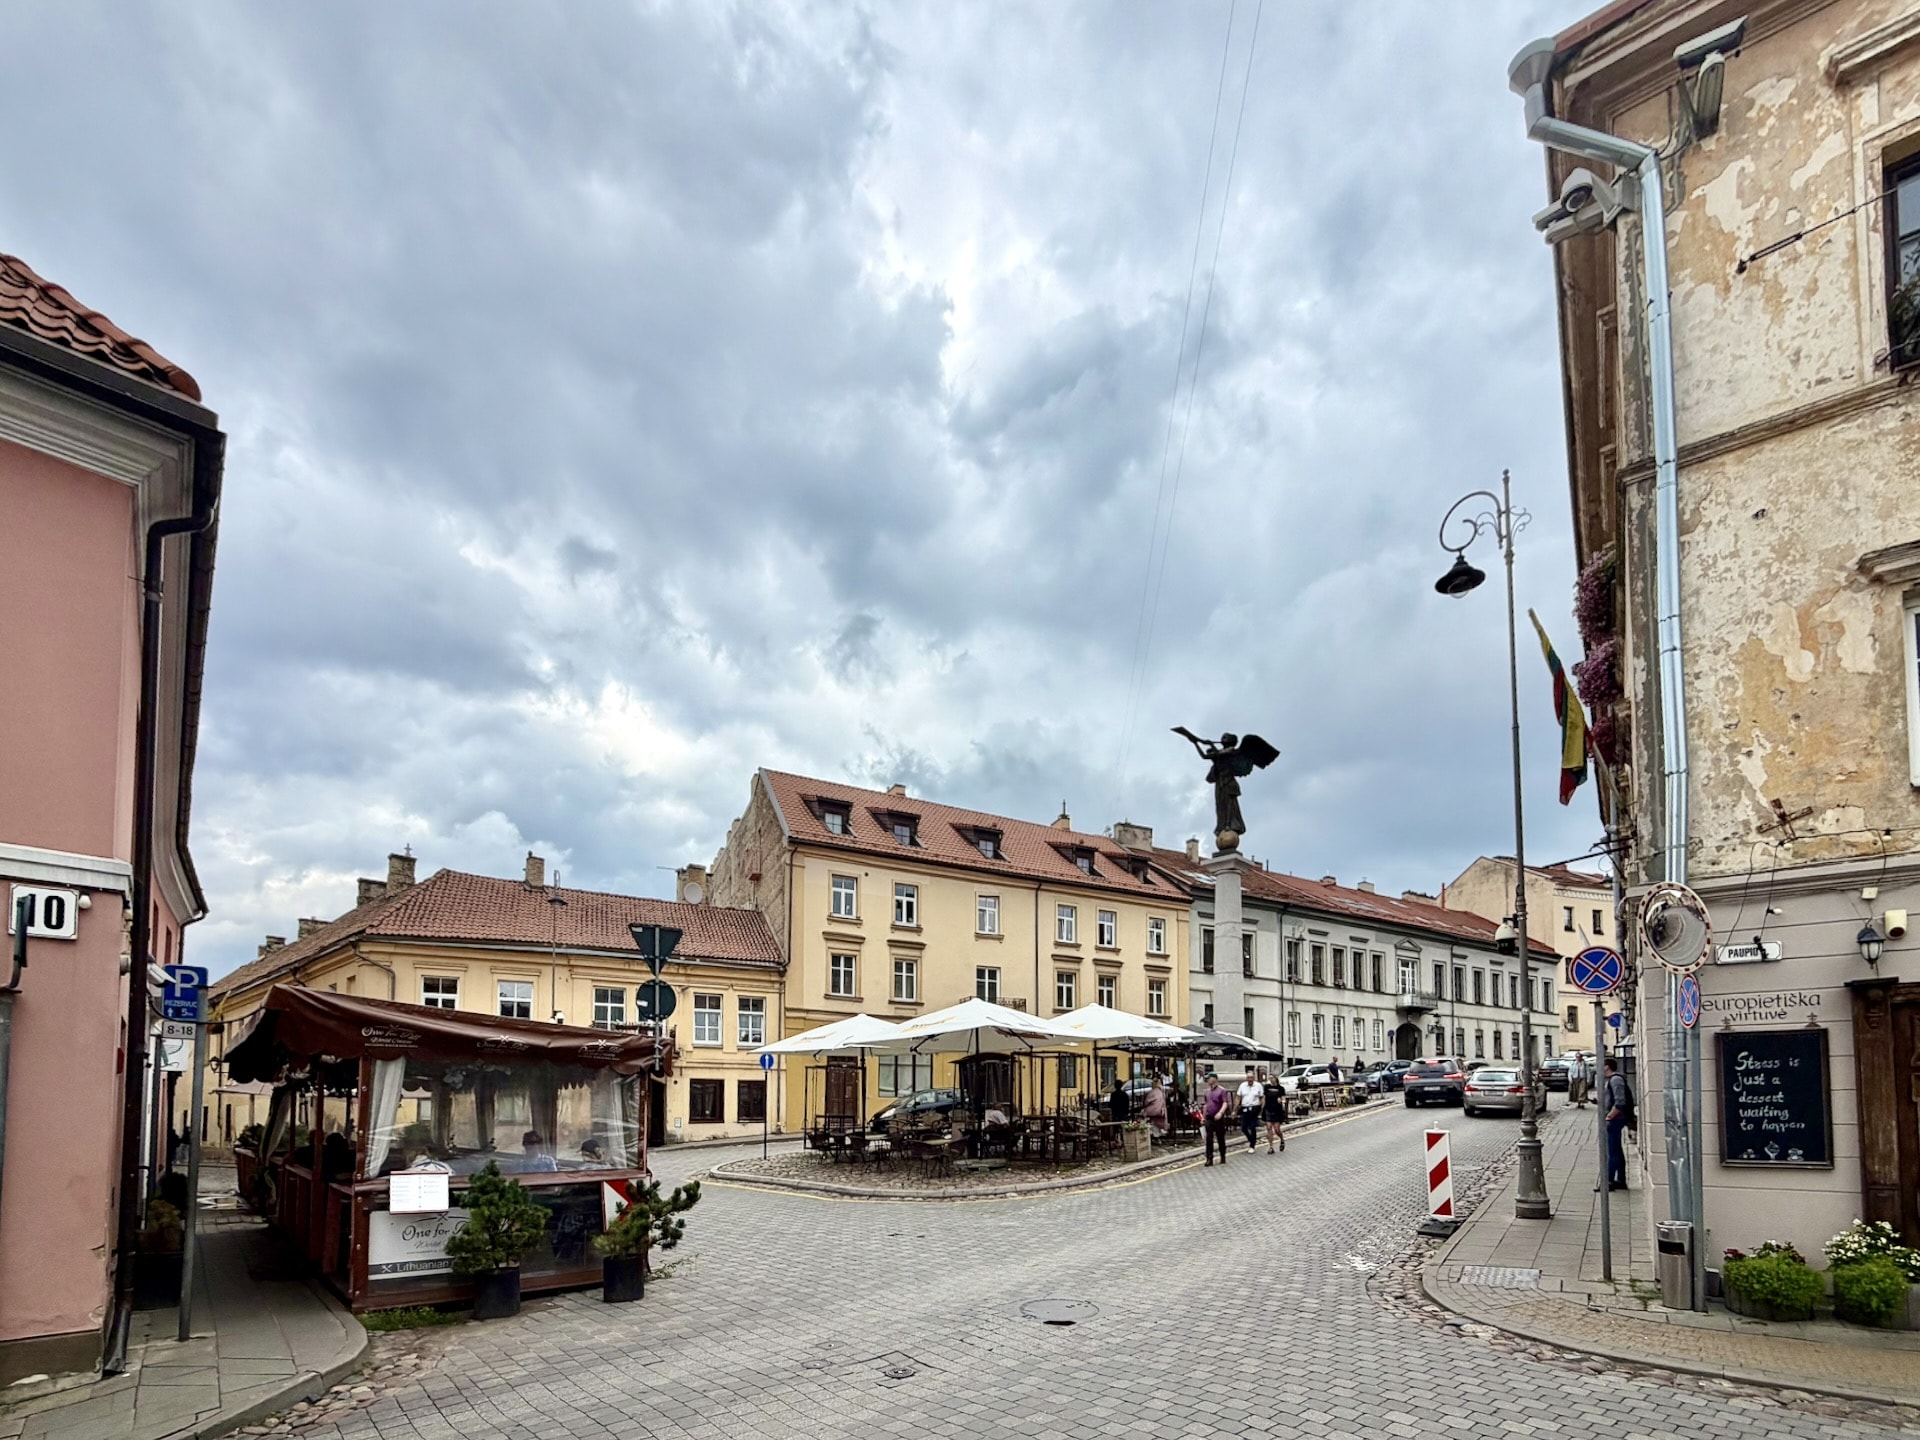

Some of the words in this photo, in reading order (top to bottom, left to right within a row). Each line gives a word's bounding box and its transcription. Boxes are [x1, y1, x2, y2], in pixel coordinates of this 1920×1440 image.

[27, 893, 65, 930] 10
[1728, 947, 1759, 959] PAUPIO
[174, 968, 200, 998] P
[1701, 991, 1821, 1013] europietiška
[1729, 1008, 1788, 1022] virtuvė
[167, 1025, 193, 1036] 8-18
[1734, 1051, 1781, 1071] Stress
[1788, 1057, 1801, 1067] is
[1733, 1072, 1766, 1092] just
[1771, 1076, 1781, 1085] a
[1738, 1091, 1785, 1104] dessert
[1738, 1105, 1790, 1121] waiting
[1740, 1119, 1755, 1131] to
[1761, 1119, 1806, 1133] happen
[402, 1224, 431, 1241] One
[432, 1222, 450, 1238] for
[396, 1259, 450, 1273] Lithuanian
